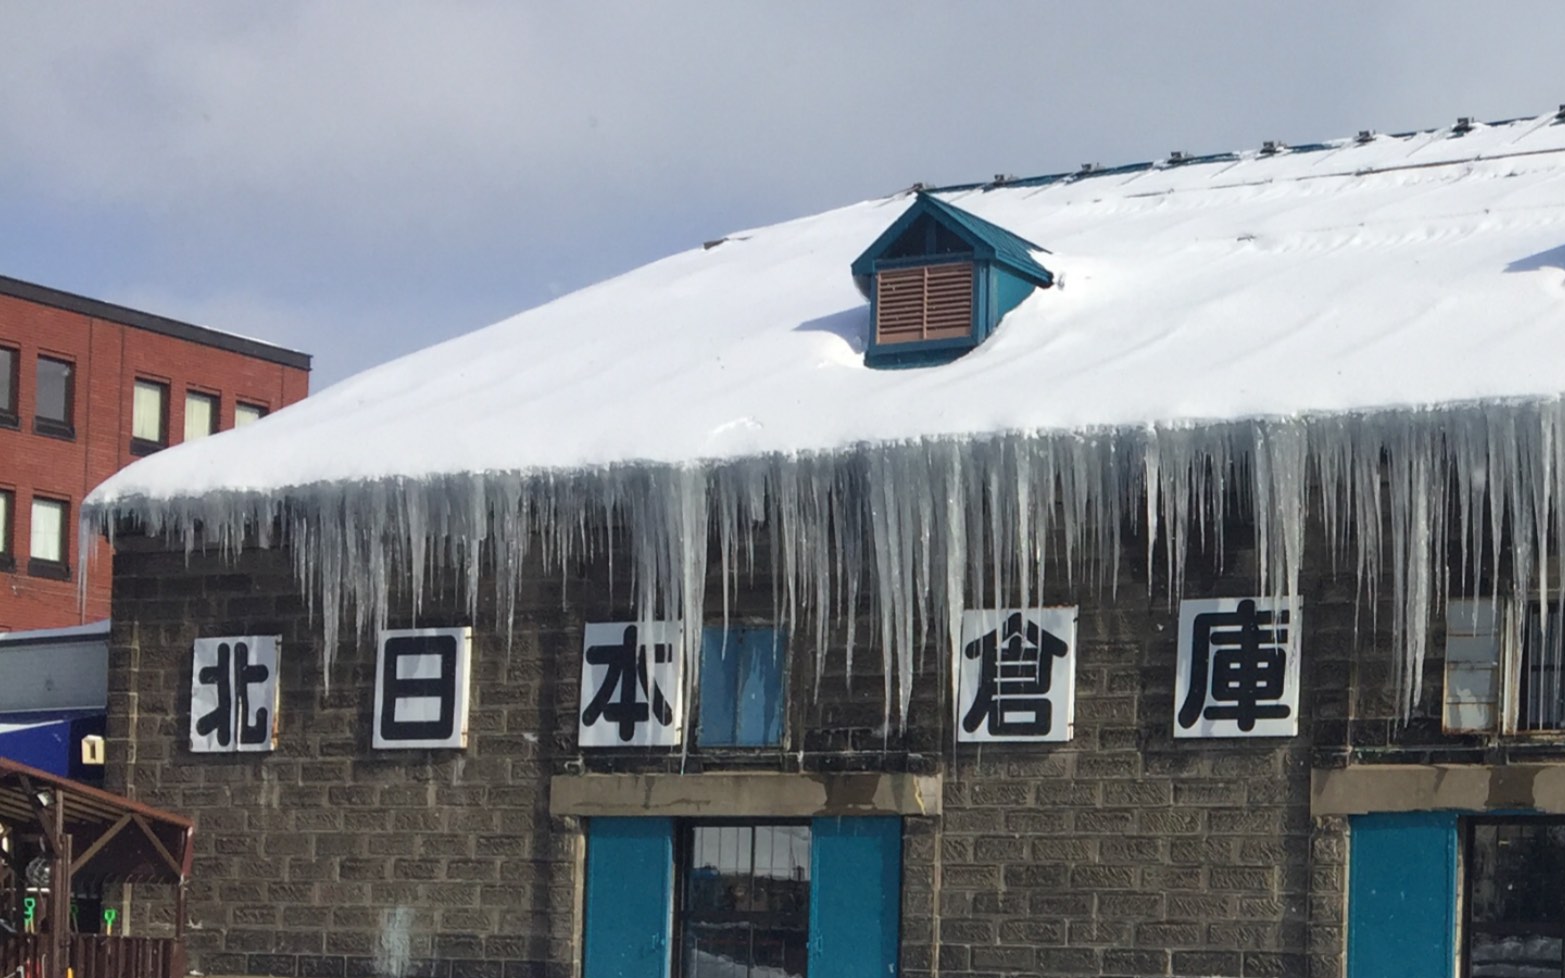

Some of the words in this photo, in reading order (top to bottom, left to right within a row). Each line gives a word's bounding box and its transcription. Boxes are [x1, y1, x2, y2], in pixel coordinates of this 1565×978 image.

[197, 642, 269, 746] 北
[381, 635, 457, 741] 日
[582, 625, 673, 741] 本
[962, 613, 1067, 737] 倉
[1179, 599, 1291, 732] 庫
